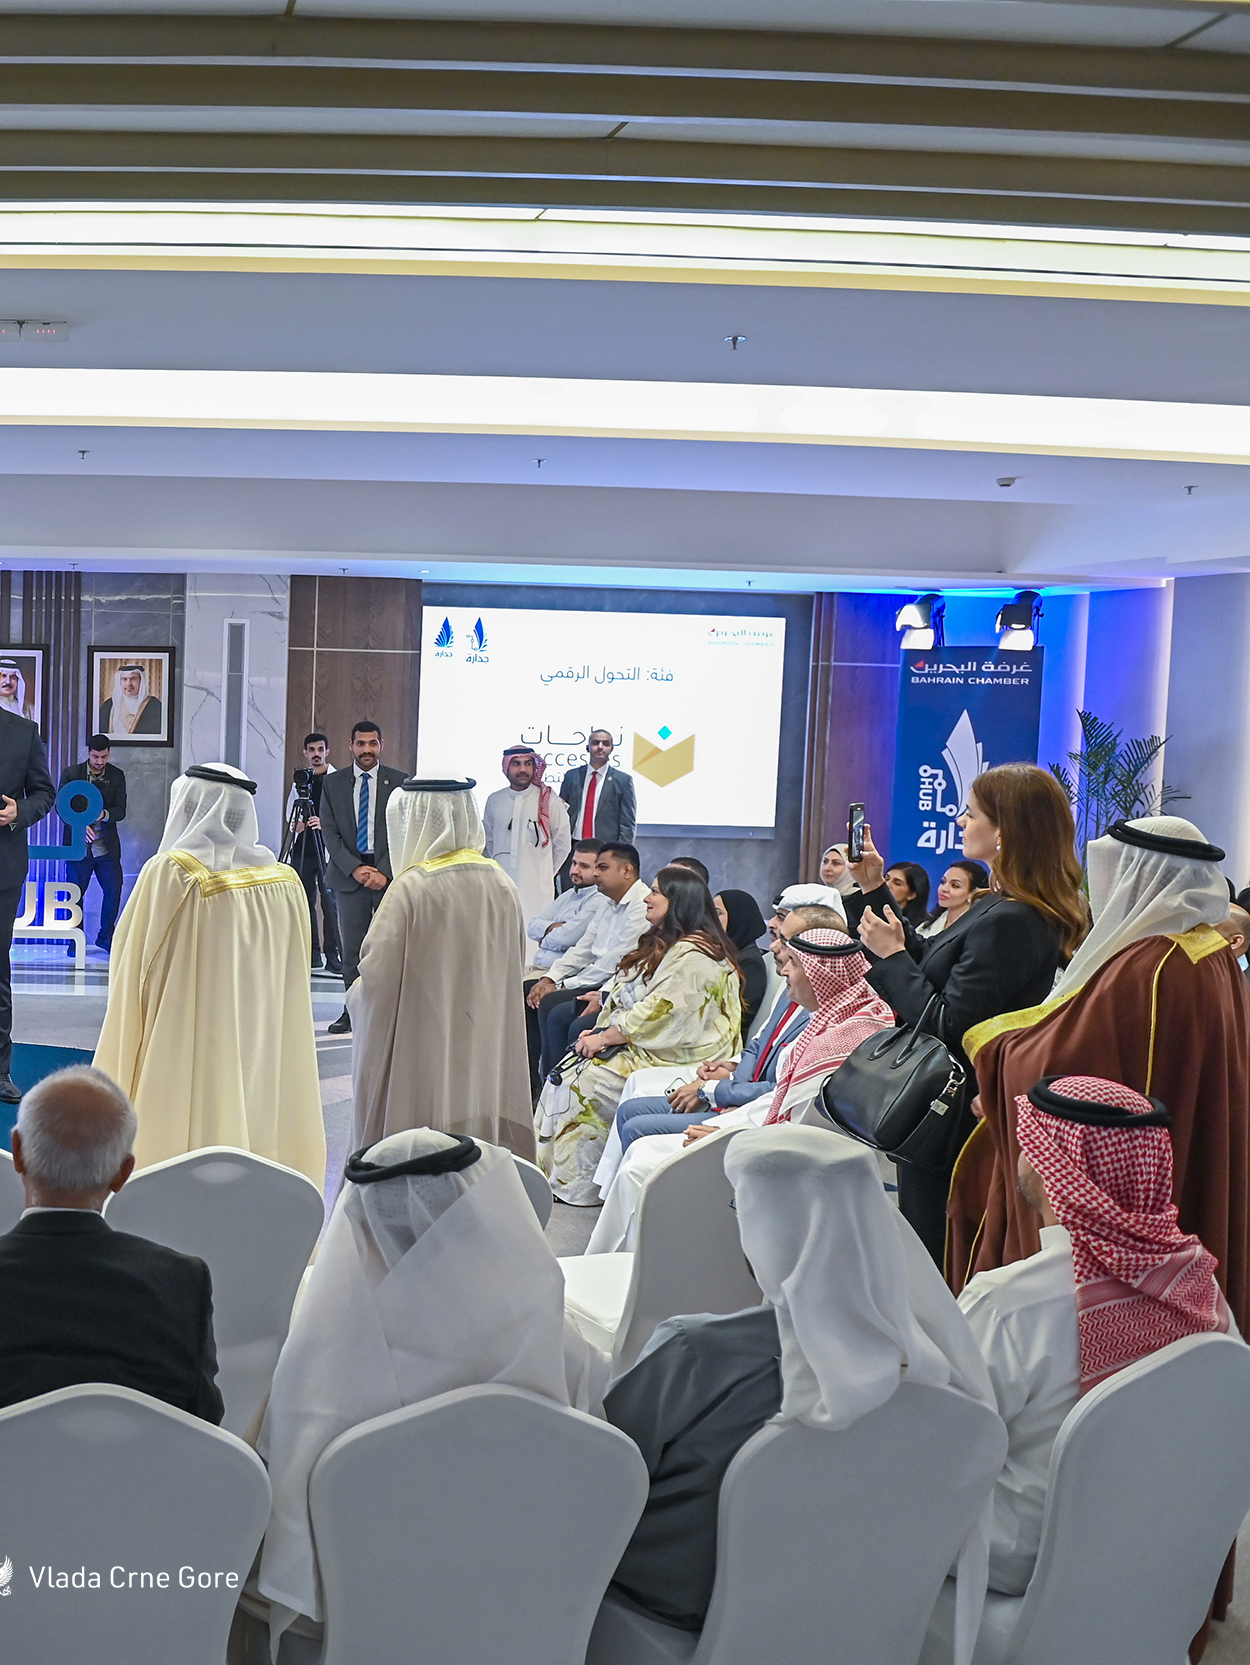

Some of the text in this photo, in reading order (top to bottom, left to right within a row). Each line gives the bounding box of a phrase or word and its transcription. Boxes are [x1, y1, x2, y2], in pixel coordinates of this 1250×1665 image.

[540, 665, 590, 686] الرقمي
[594, 667, 640, 684] التحول
[910, 659, 1033, 675] غرفة البحرين
[911, 676, 1029, 685] BAHRAIN CHAMBER
[919, 778, 932, 811] HUB
[13, 881, 83, 929] UB
